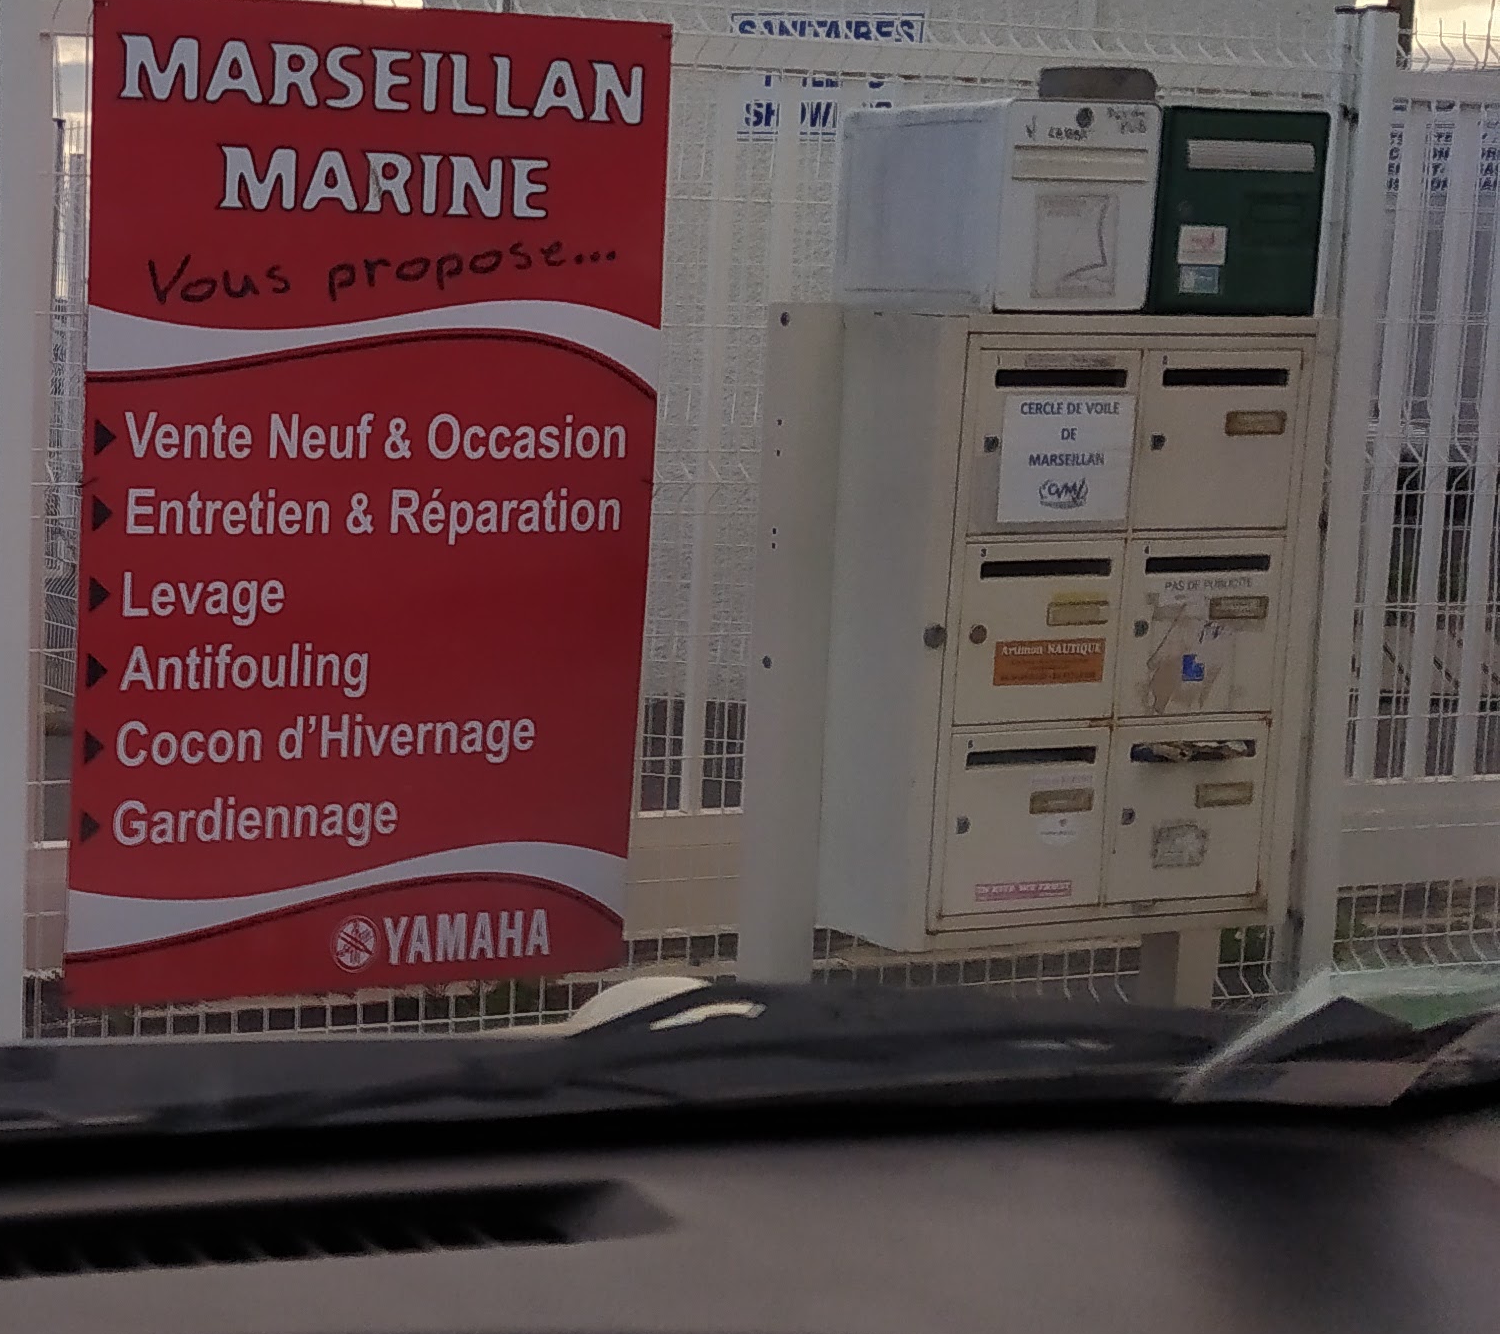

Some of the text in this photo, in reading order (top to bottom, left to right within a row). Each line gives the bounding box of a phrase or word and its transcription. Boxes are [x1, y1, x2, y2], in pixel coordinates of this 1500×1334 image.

[117, 33, 644, 124] MARSEILLAN
[216, 144, 550, 219] MARINE
[147, 239, 618, 306] Vous propose...
[1020, 401, 1120, 415] CERCLE DE VOILE
[1061, 428, 1078, 441] DE
[124, 411, 627, 461] Vente Neuf & Occasion
[1029, 453, 1104, 466] MARSEILLAN
[125, 487, 622, 546] Entretien & Réparation
[122, 571, 286, 627] Levage
[119, 643, 369, 698] Antifouling
[116, 713, 536, 768] Cocon d'Hivernage
[112, 796, 398, 848] Gardiennage
[383, 909, 551, 965] YAMAHA
